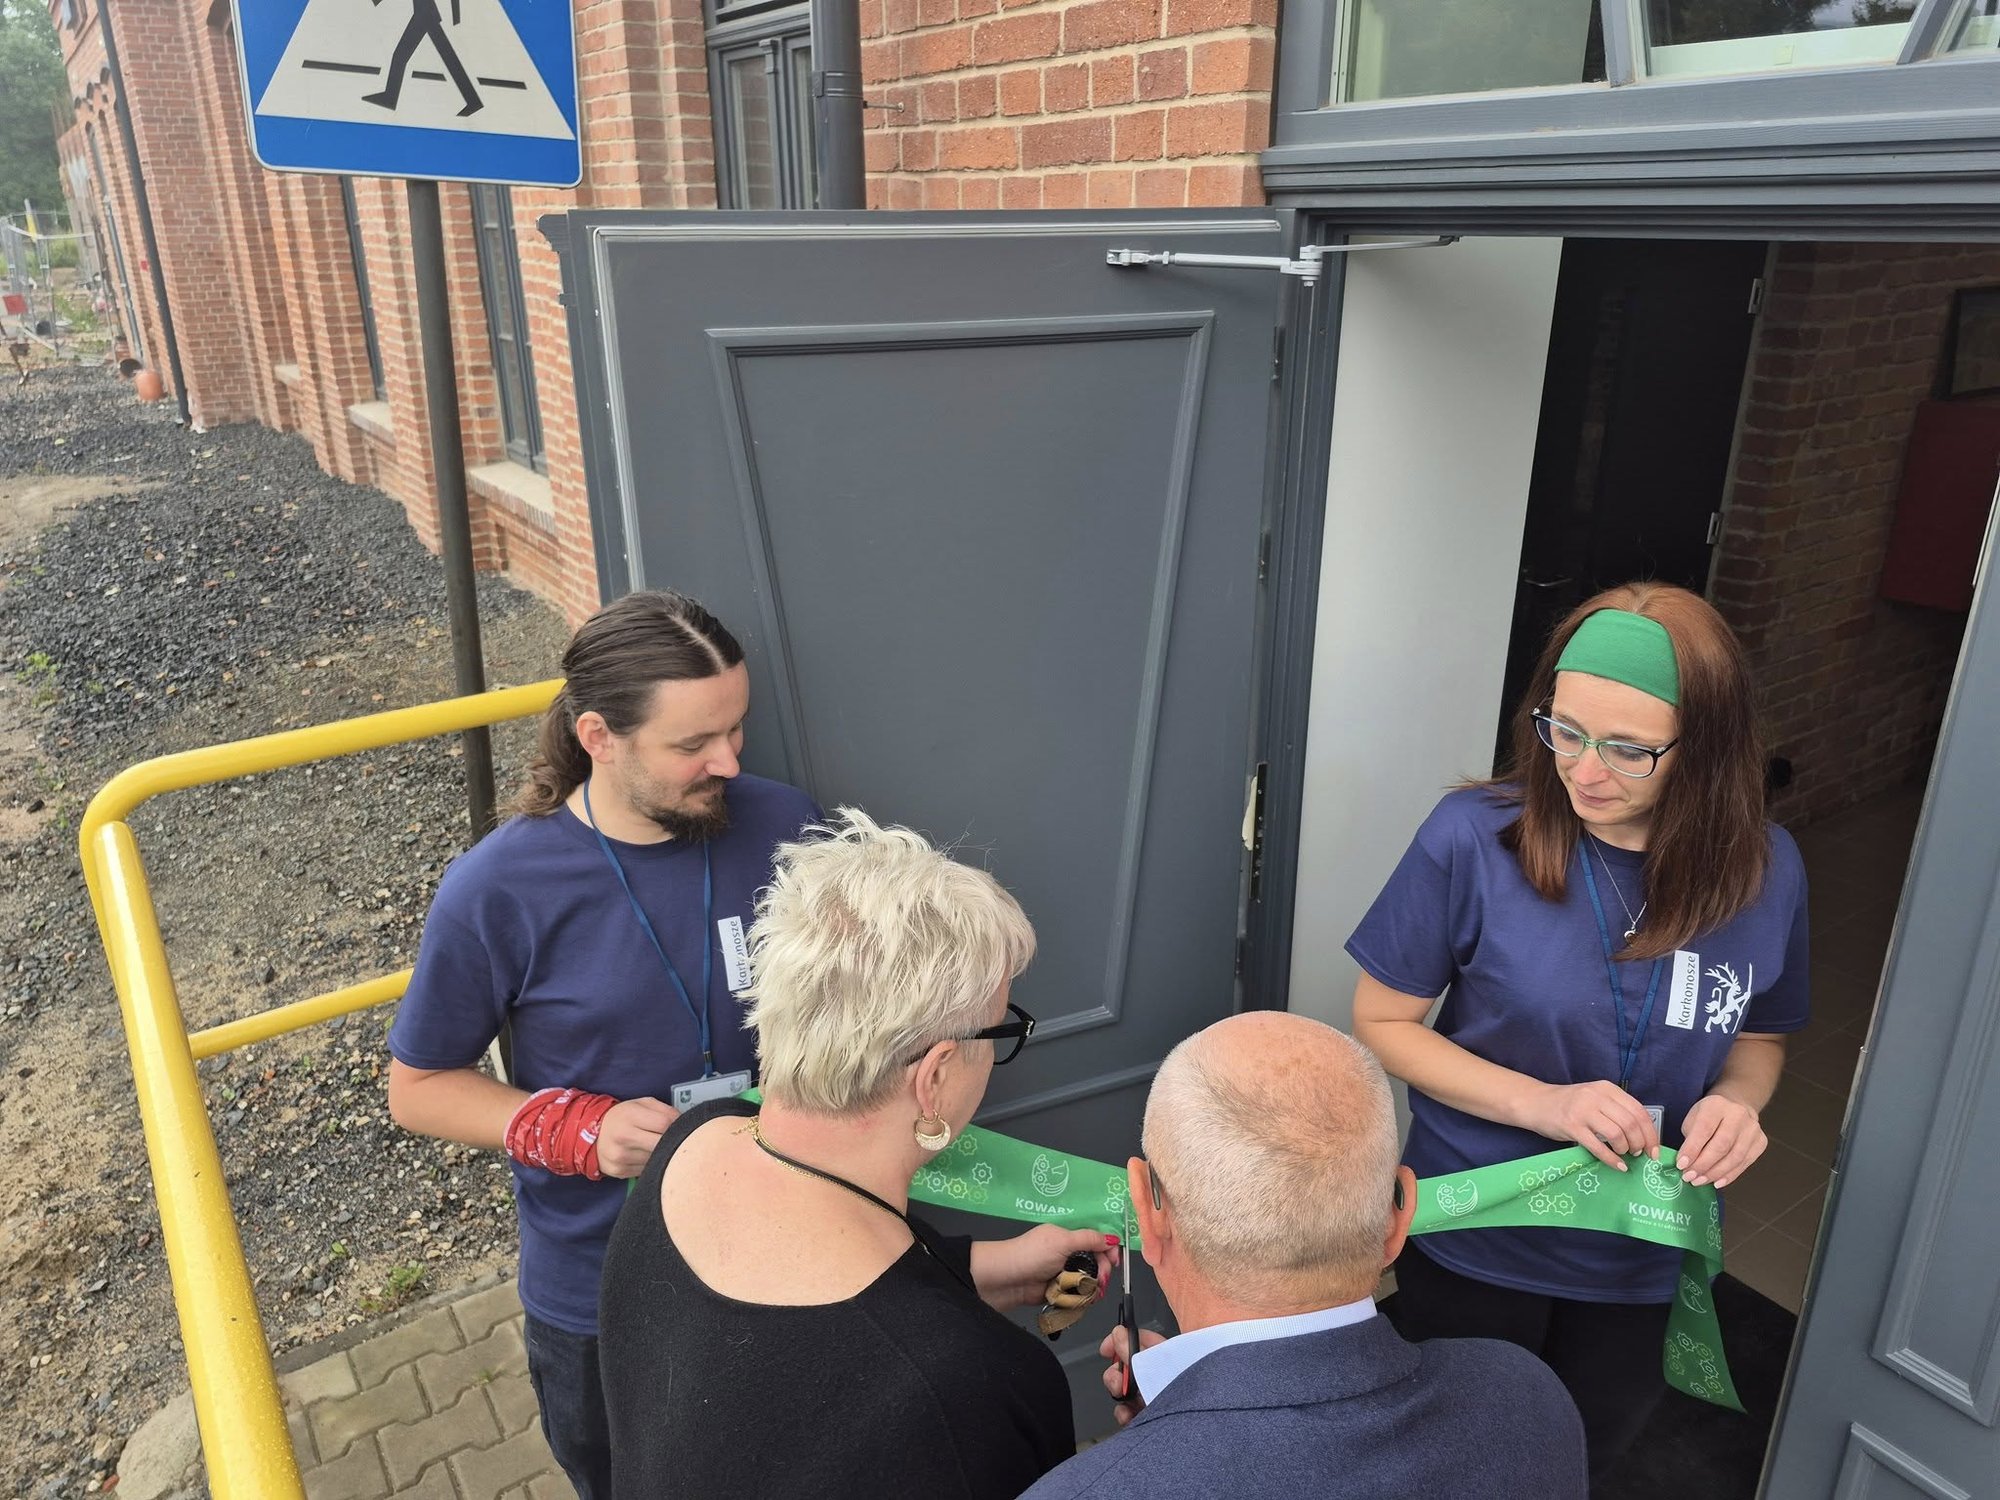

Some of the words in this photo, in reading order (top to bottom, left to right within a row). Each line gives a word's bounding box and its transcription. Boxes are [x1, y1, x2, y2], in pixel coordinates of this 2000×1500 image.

[1677, 955, 1696, 1026] Karkonosze
[1015, 1197, 1075, 1215] KOWARY
[1628, 1202, 1692, 1226] KOWARY
